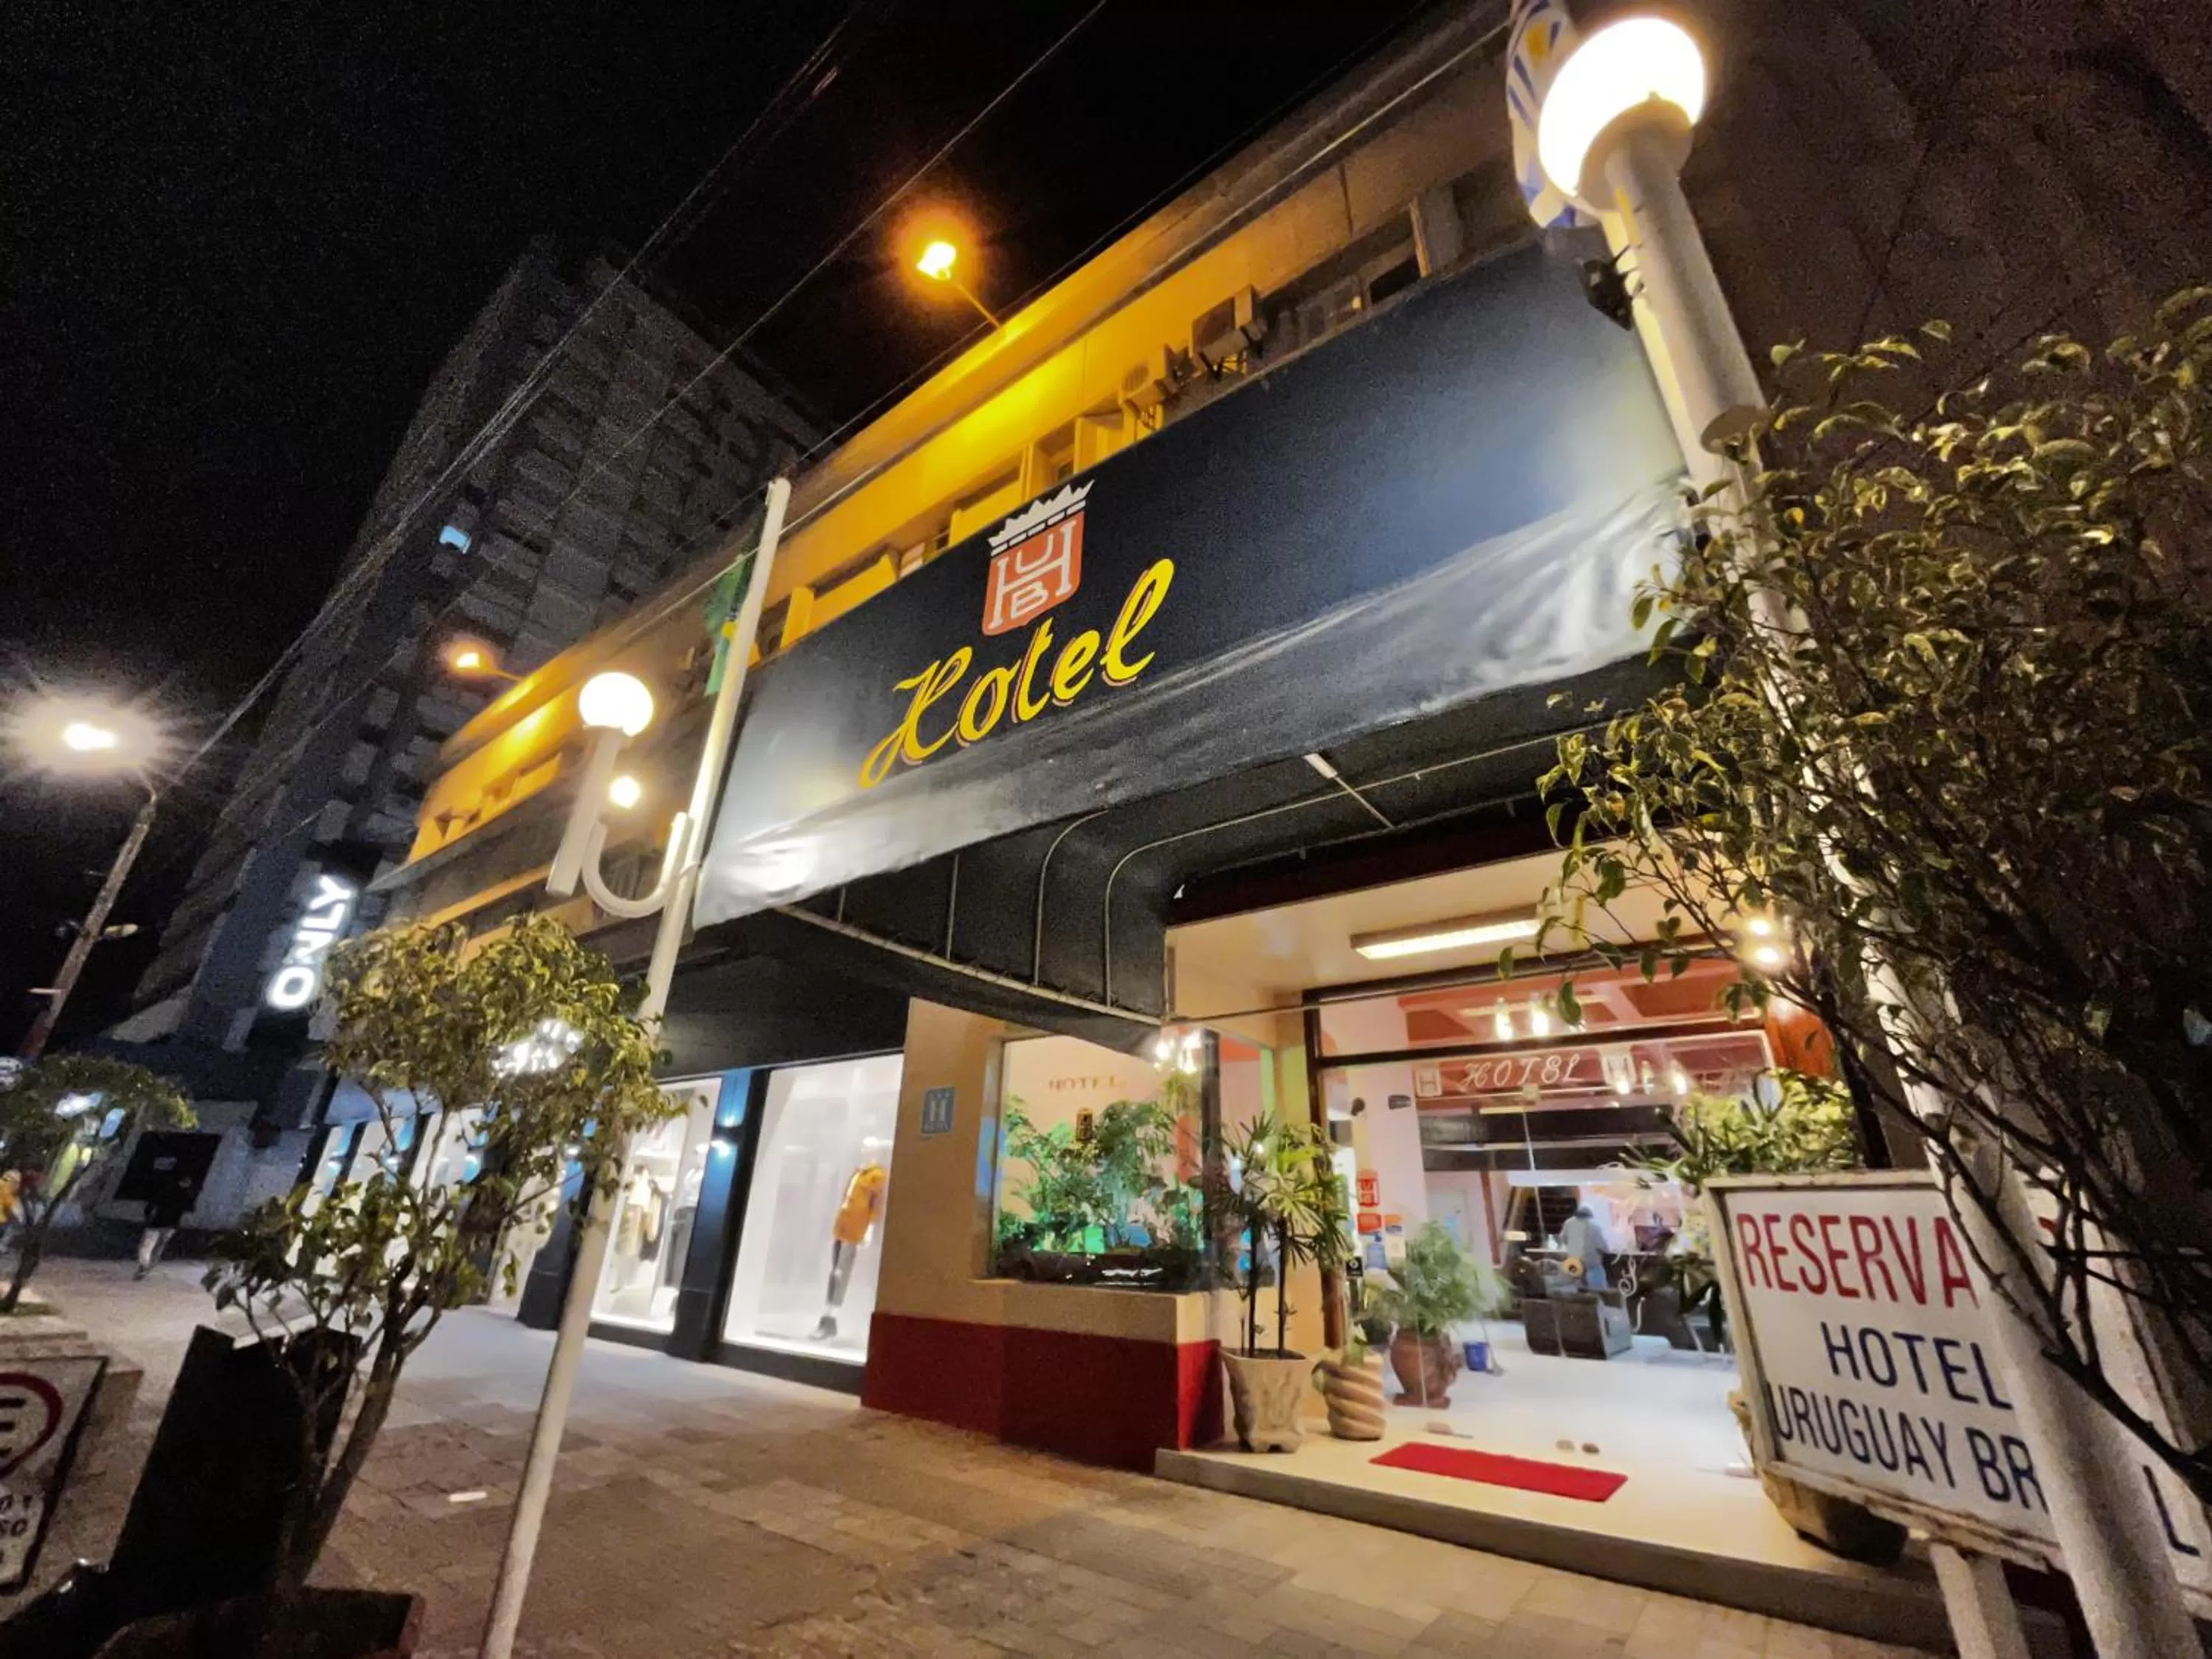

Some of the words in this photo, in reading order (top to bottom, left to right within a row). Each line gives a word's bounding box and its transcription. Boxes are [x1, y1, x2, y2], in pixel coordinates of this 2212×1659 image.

[858, 558, 1175, 789] Hotel
[267, 874, 352, 1010] ONLY
[1461, 1053, 1585, 1087] HOTEL
[1736, 1213, 2061, 1315] RESERVA
[1820, 1321, 2014, 1411] HOTEL
[1766, 1380, 1955, 1489] URUGUAY
